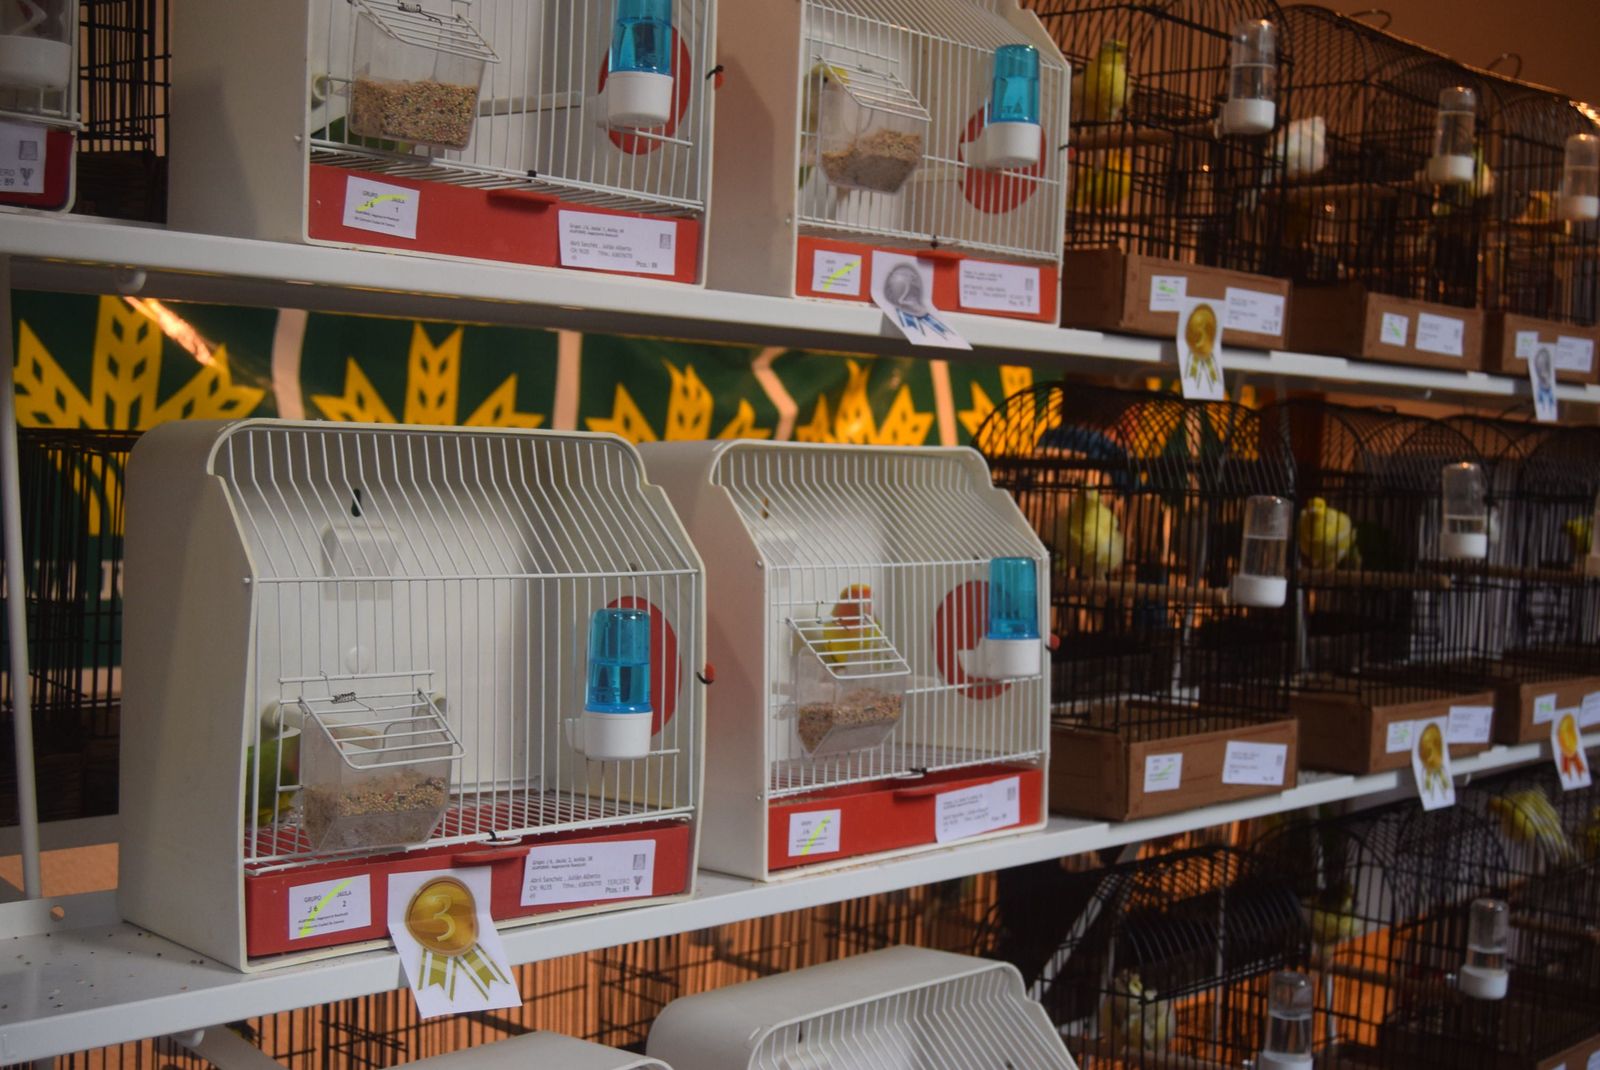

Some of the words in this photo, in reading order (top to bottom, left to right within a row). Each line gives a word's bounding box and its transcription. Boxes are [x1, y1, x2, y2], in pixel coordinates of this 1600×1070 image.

[896, 275, 920, 308] 2
[303, 895, 322, 903] GRUPO
[336, 890, 352, 898] JAULA
[342, 900, 347, 908] 2
[432, 894, 457, 942] 3
